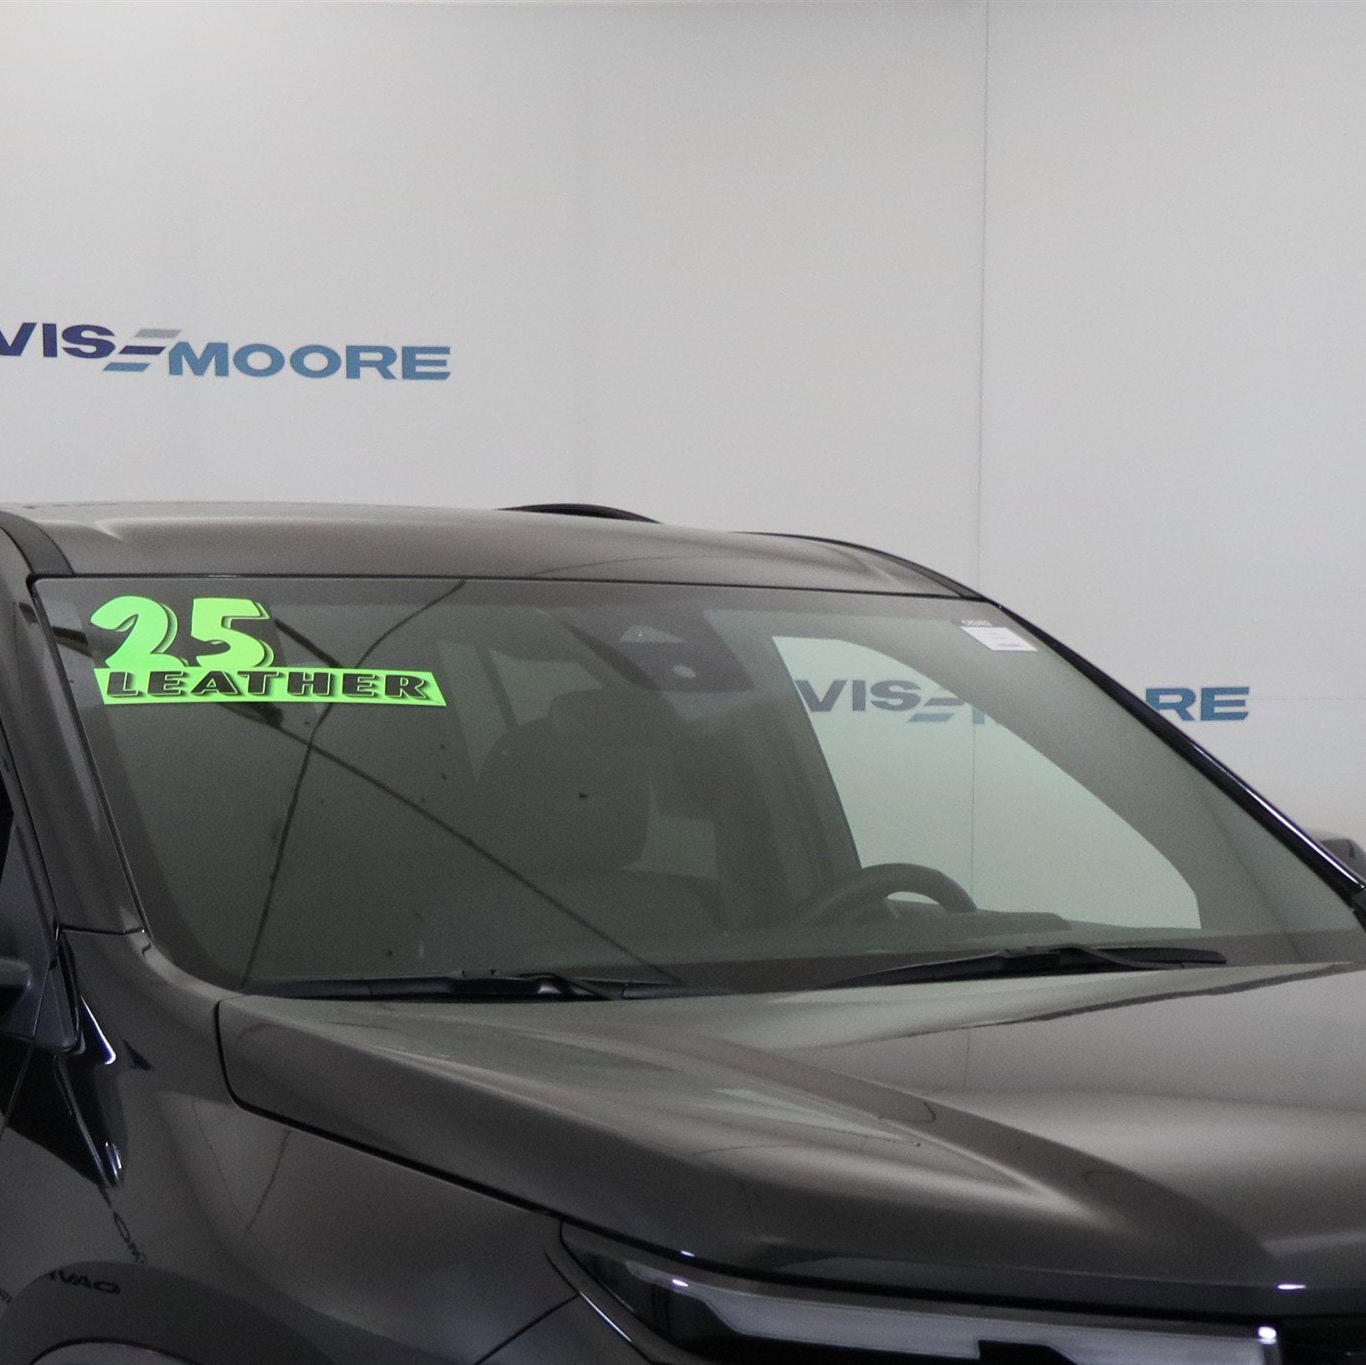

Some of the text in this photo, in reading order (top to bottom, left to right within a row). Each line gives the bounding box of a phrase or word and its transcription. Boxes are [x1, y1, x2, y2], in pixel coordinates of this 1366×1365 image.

[169, 342, 451, 380] MOORE
[90, 595, 275, 667] 25
[106, 670, 432, 700] LEATHER
